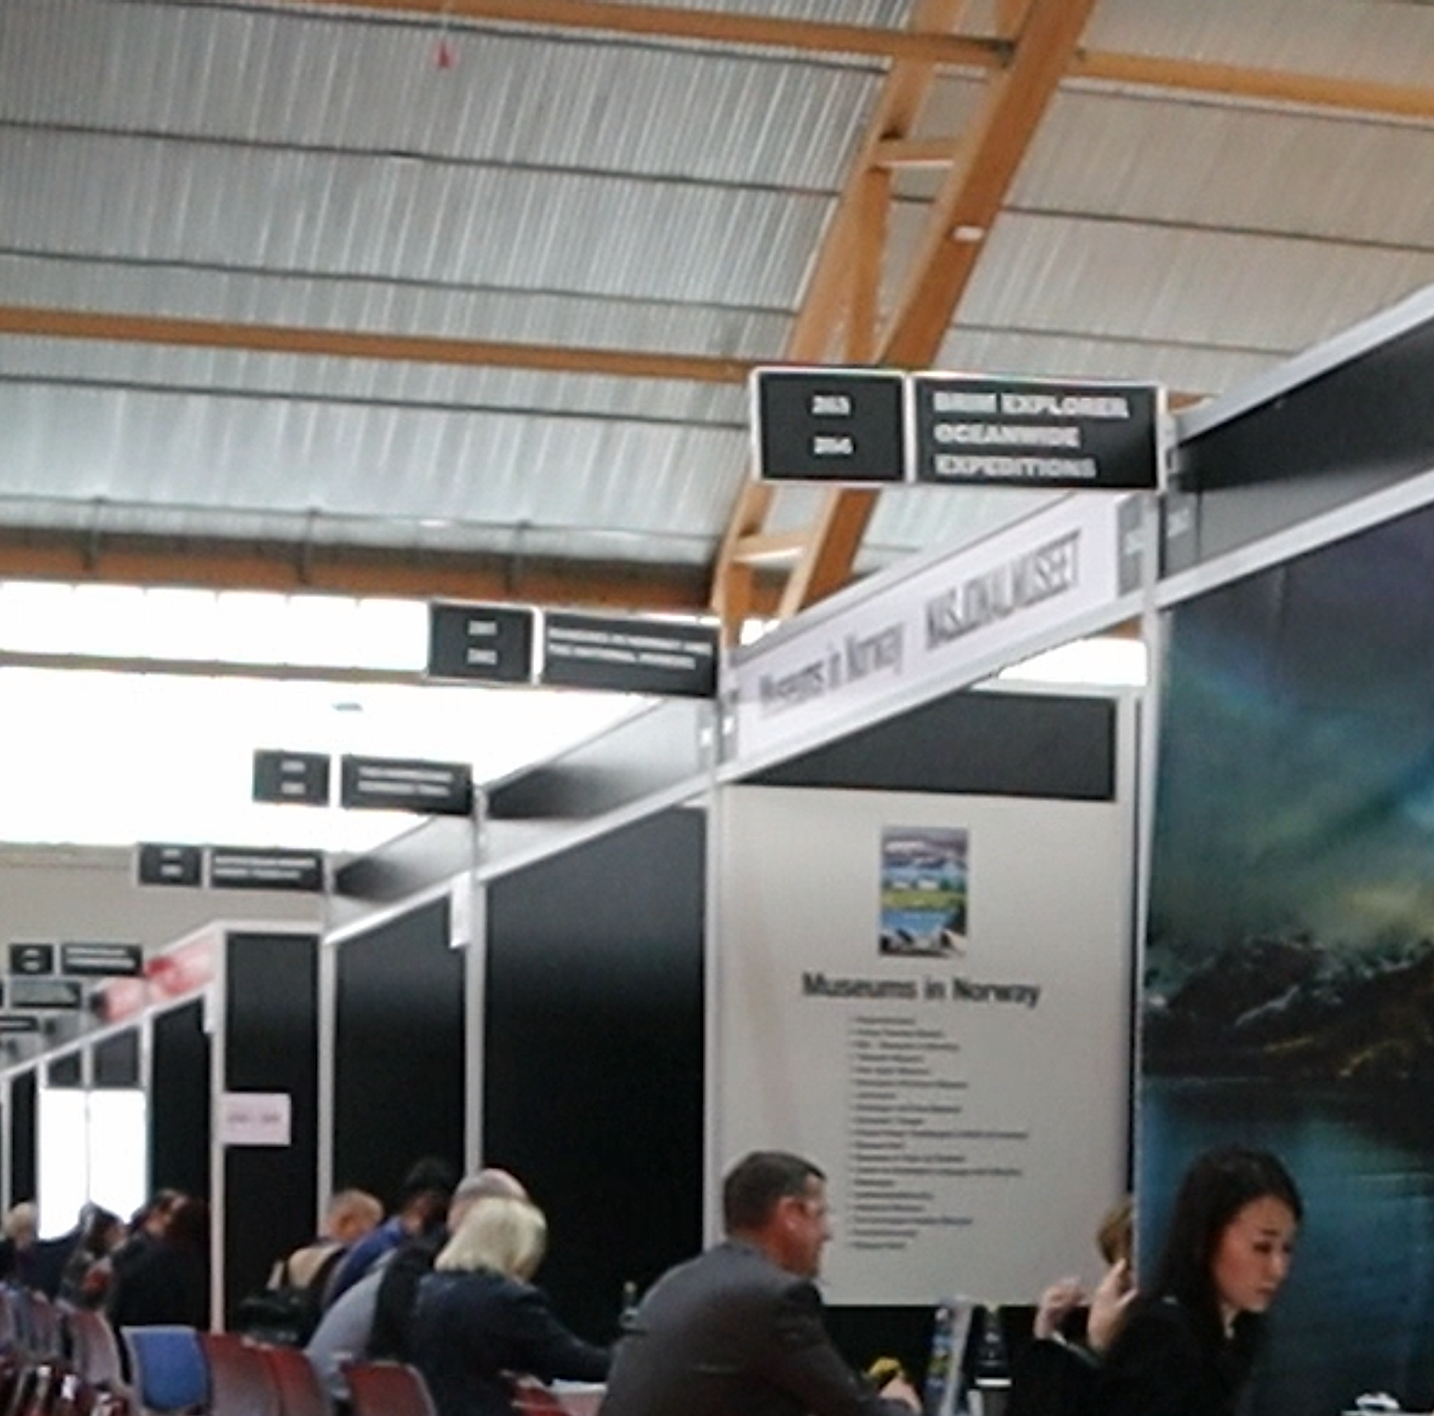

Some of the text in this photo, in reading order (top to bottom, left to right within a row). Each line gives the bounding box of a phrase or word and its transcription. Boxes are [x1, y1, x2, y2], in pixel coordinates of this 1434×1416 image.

[1000, 393, 1130, 418] EXPLORER
[933, 422, 1082, 448] OCEANWIDE
[933, 453, 1097, 479] EXPEDITIONS
[802, 971, 1041, 1010] Museums in Norway
